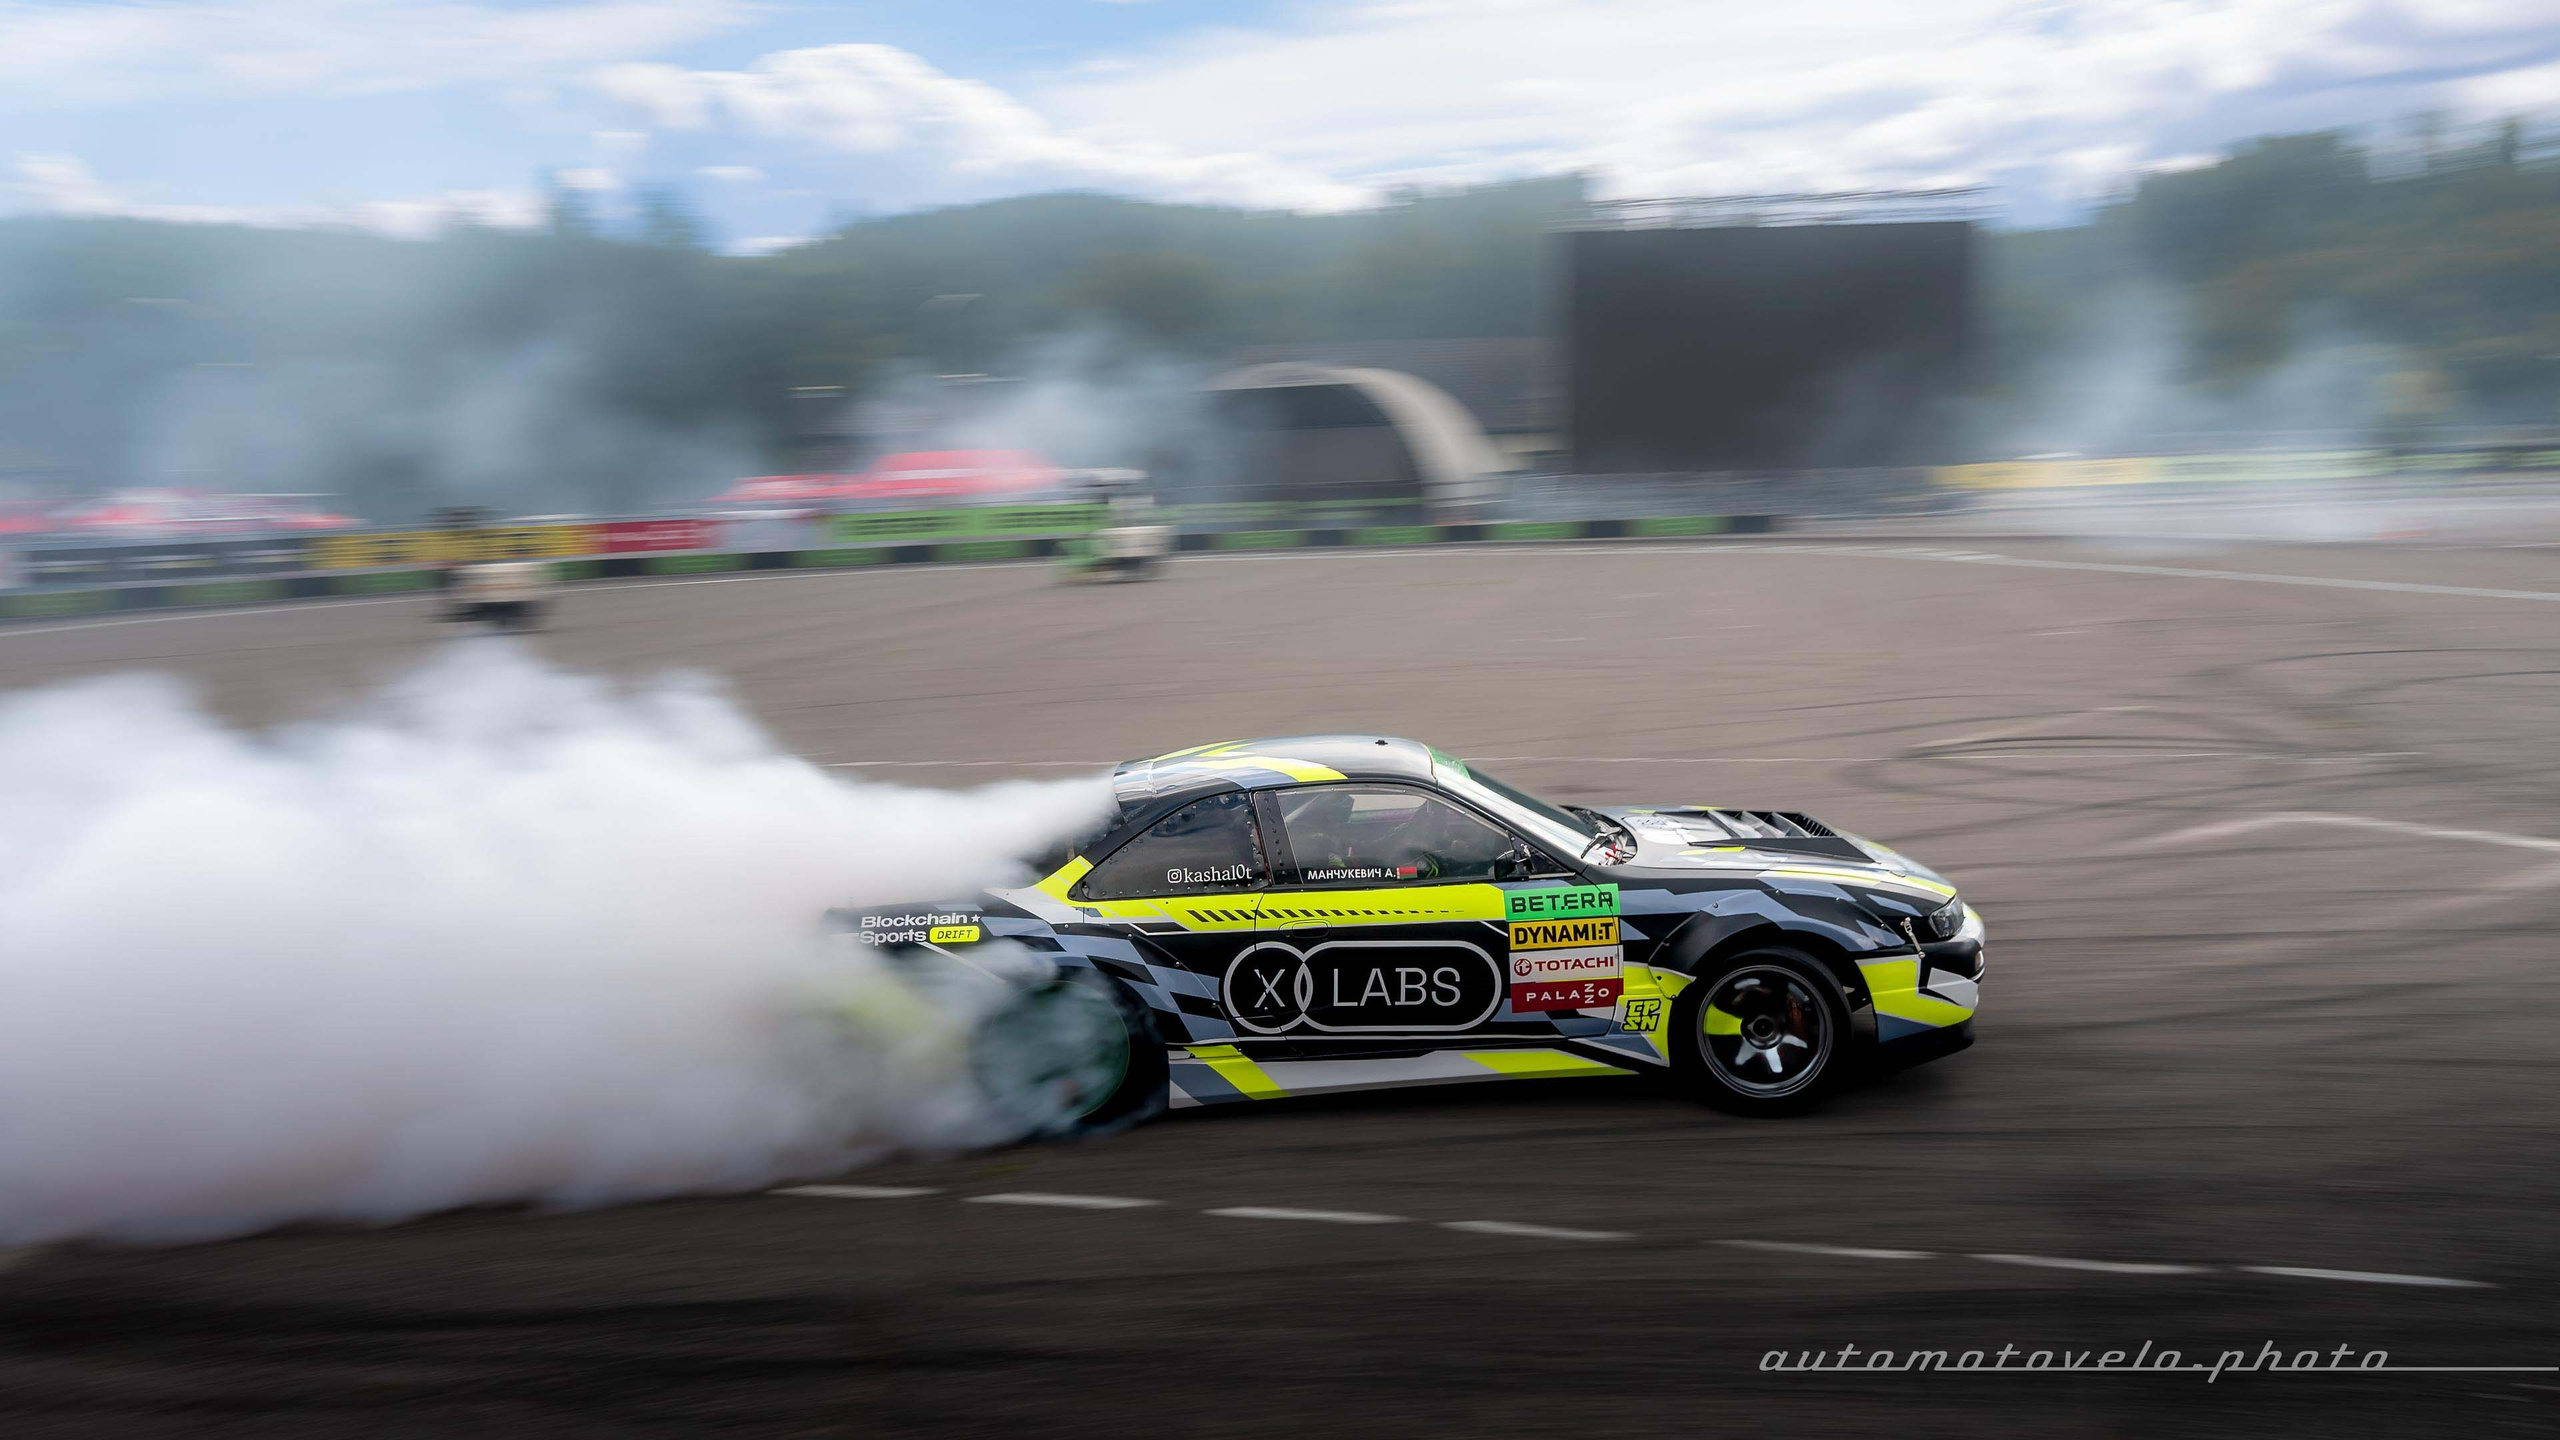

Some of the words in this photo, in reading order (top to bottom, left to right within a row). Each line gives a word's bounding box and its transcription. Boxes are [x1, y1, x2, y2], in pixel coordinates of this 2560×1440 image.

[1307, 868, 1382, 880] МАНЧУКЕВИЧ
[860, 912, 968, 928] Blockchain
[859, 929, 927, 946] Sports
[936, 929, 974, 940] DRIFT
[1534, 956, 1614, 972] TOTACHI
[1254, 968, 1286, 1009] X
[1333, 967, 1461, 1007] LABS
